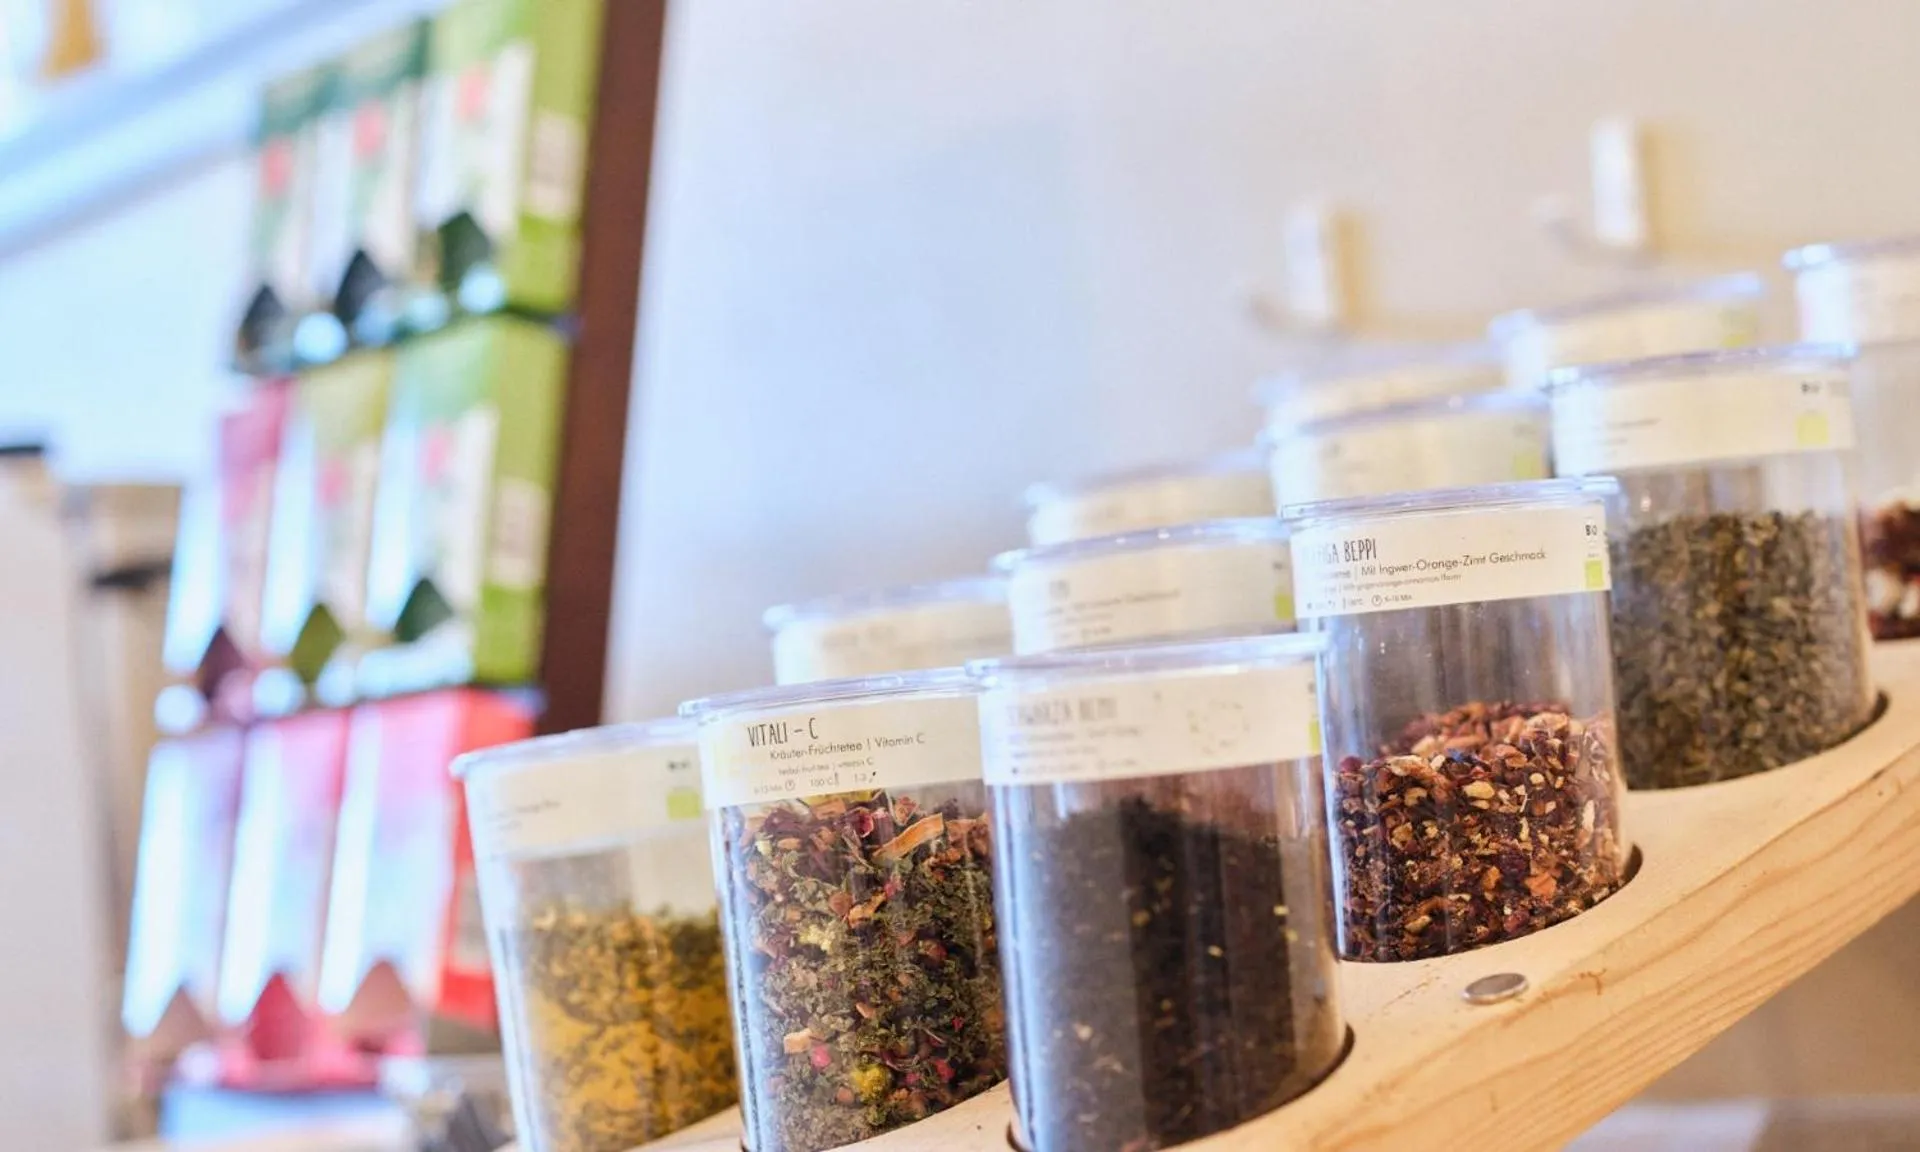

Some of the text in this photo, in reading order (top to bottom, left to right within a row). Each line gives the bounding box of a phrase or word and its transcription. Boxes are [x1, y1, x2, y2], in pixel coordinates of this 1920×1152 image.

[1343, 538, 1378, 563] BEPPI
[1361, 565, 1376, 577] Mit
[1379, 553, 1486, 576] Ingwer-Orange-Zimt
[1489, 550, 1546, 564] Geschmack
[747, 721, 788, 748] VITALI
[808, 717, 820, 740] C
[874, 735, 914, 749] Vitamin
[916, 732, 926, 744] C
